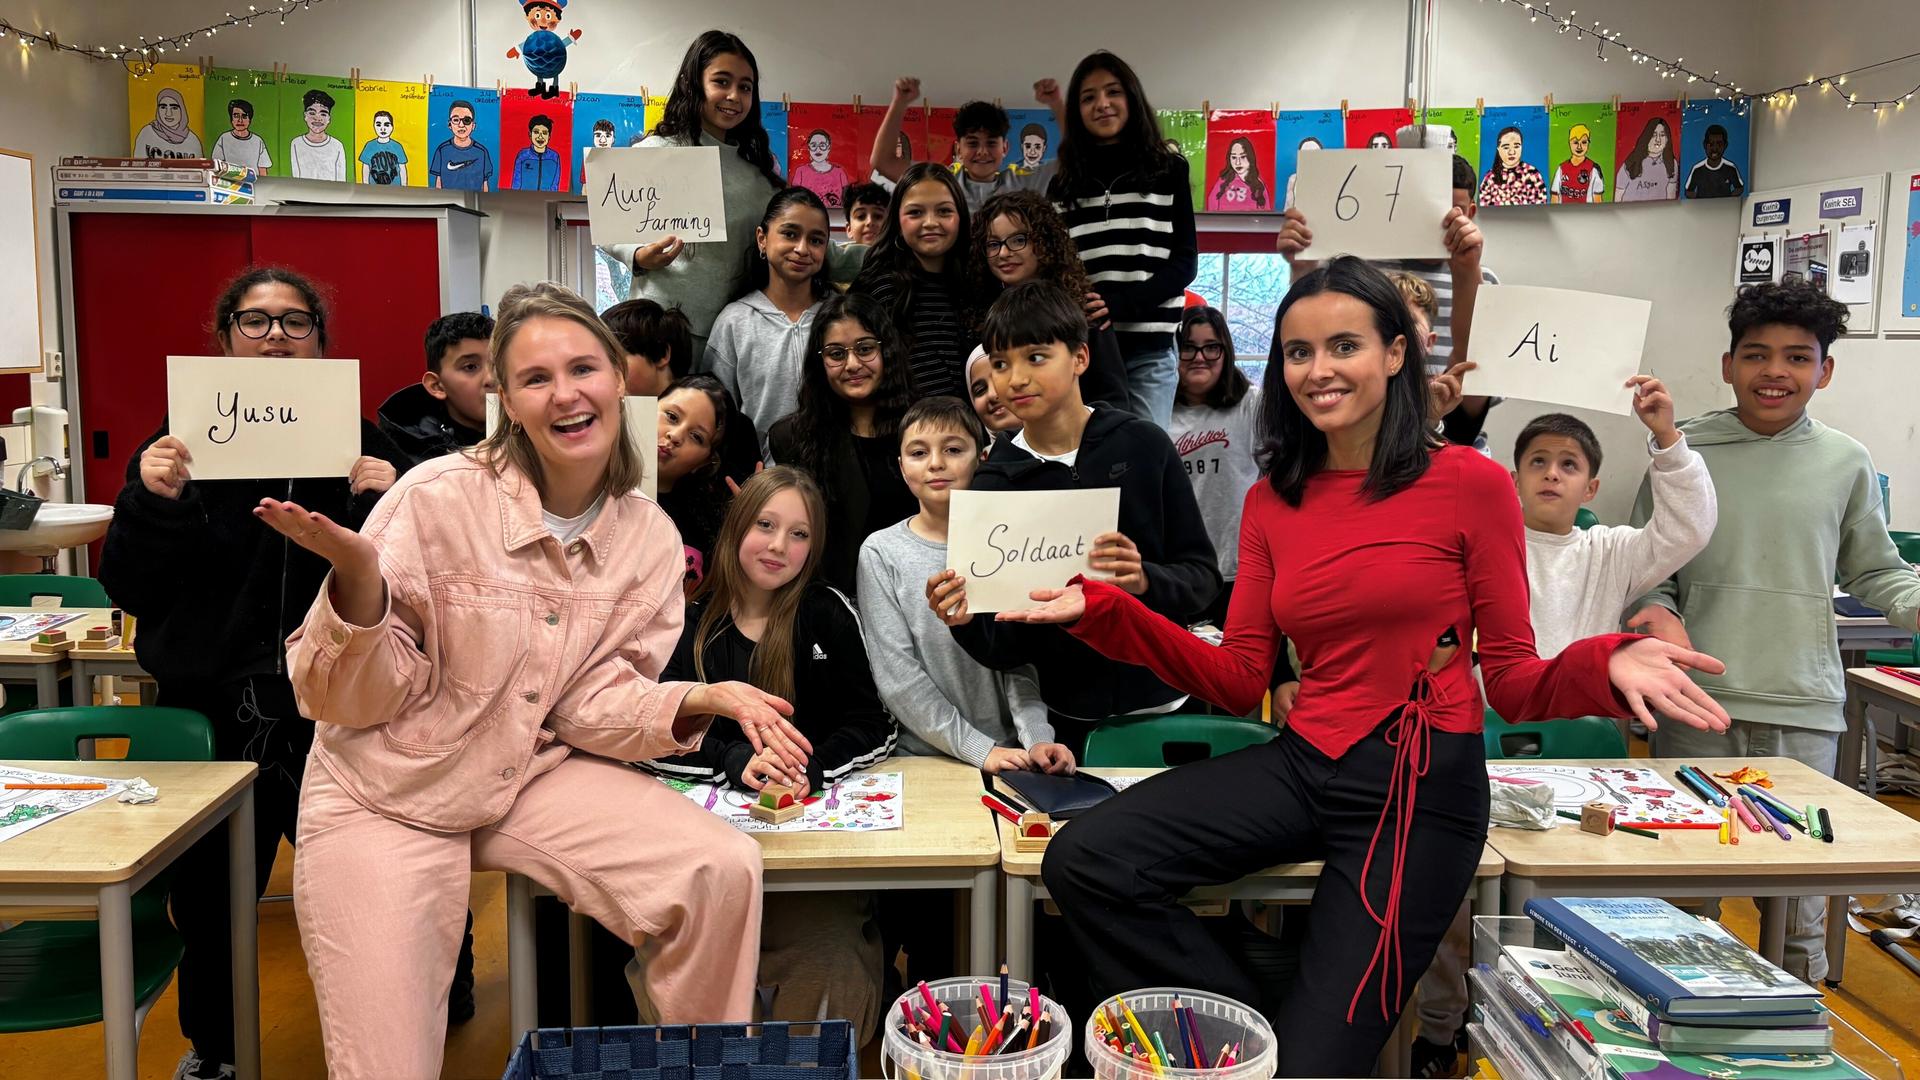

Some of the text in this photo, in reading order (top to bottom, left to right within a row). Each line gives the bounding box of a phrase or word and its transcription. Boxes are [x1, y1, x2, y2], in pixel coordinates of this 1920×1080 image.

[359, 82, 388, 92] Gabriel
[1551, 106, 1571, 118] Thor
[601, 172, 661, 212] Aura
[1824, 197, 1856, 208] Kwink SEL
[1756, 212, 1784, 223] burgerschap
[1762, 202, 1779, 211] Kwink
[636, 200, 711, 238] farming
[1508, 322, 1559, 362] Ai
[208, 391, 298, 444] Yusu
[1175, 428, 1230, 456] Athletics
[970, 523, 1085, 578] Soldaat
[1582, 946, 1601, 963] Zwarte
